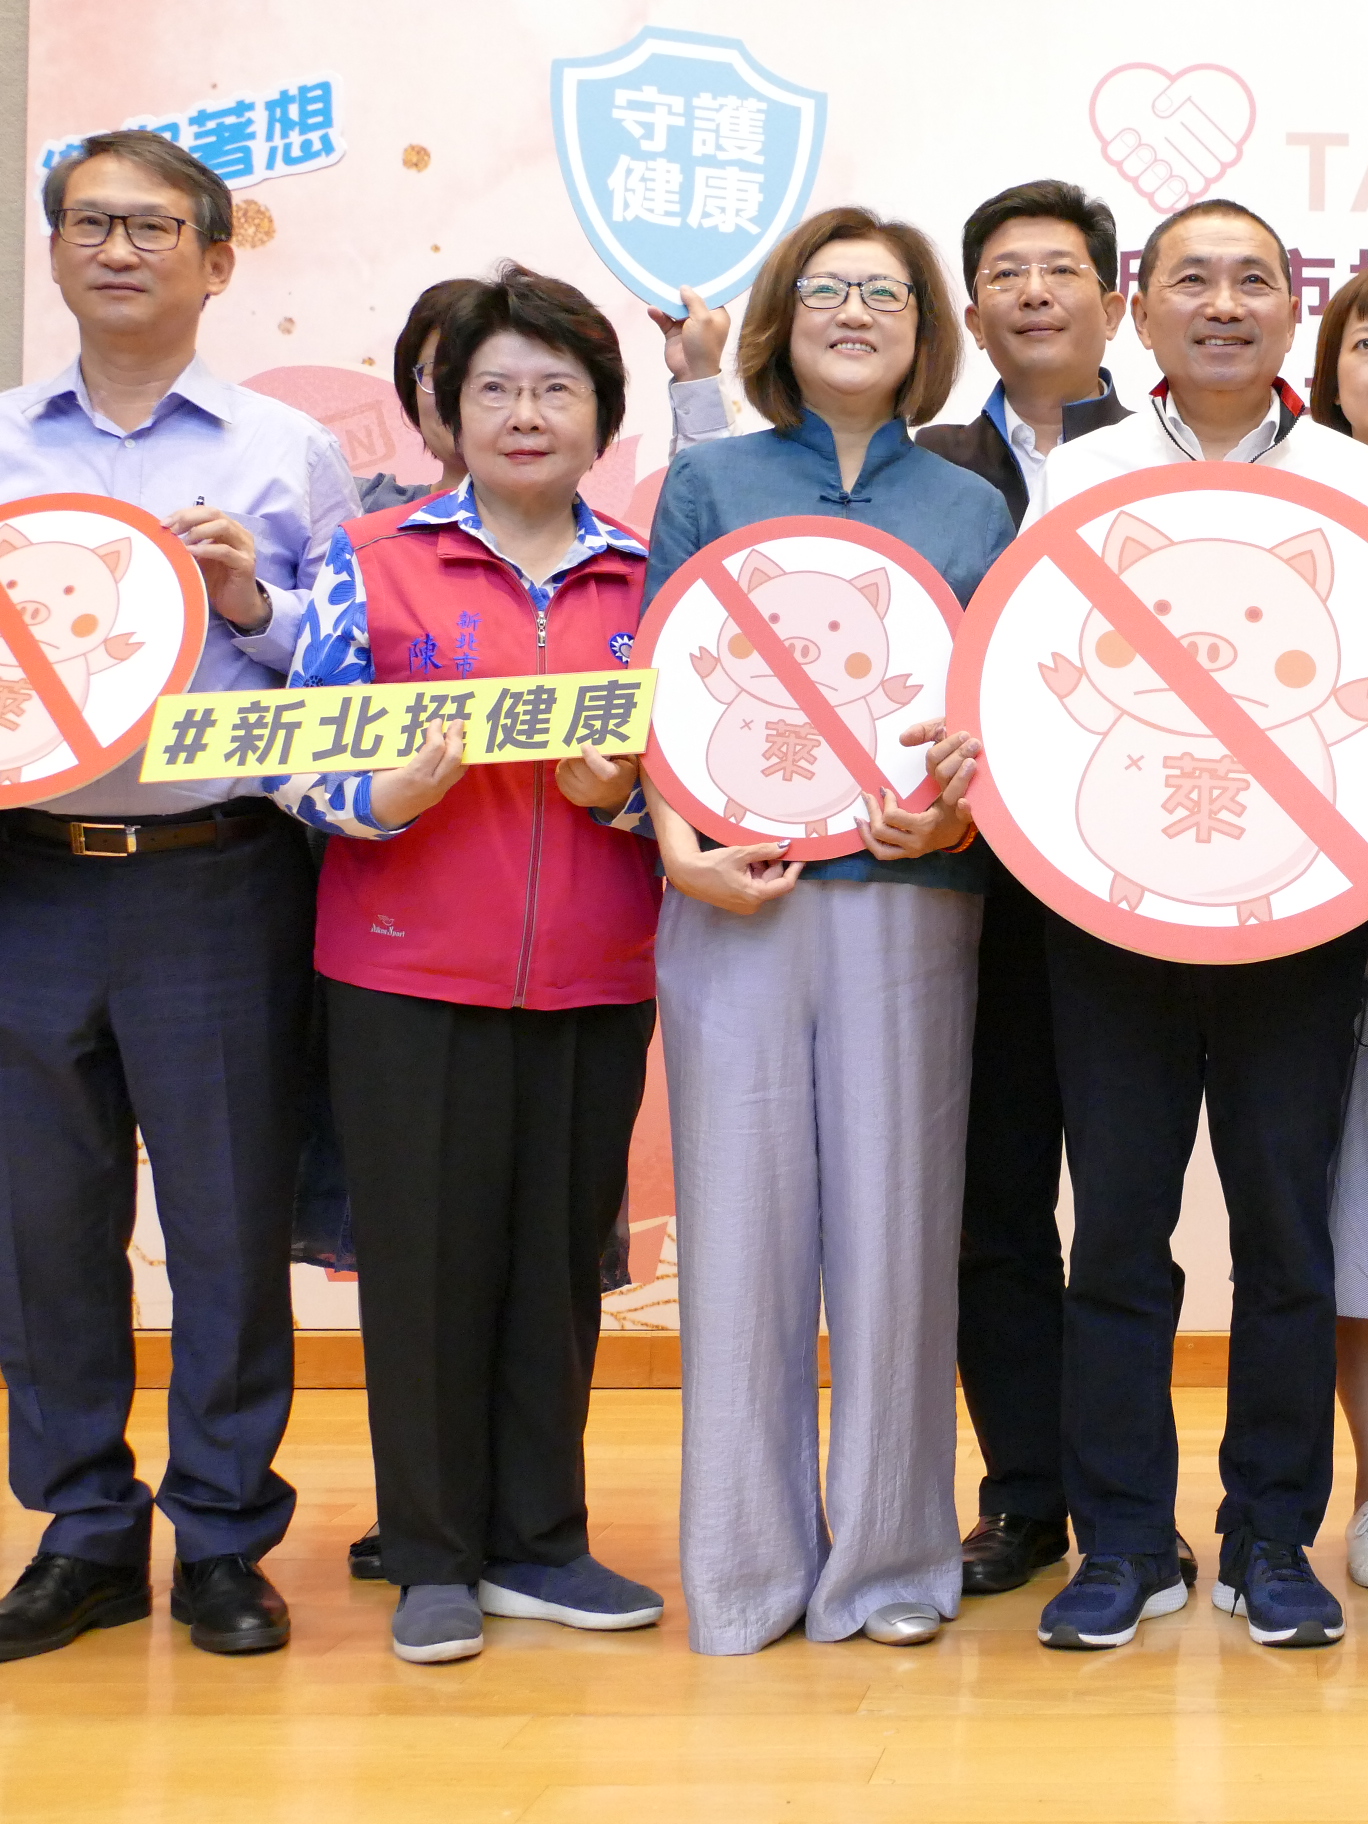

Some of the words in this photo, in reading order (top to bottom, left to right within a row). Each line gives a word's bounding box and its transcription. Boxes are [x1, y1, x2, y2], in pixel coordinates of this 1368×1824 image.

[43, 81, 335, 181] 著想
[612, 85, 767, 165] 守護
[607, 154, 764, 235] 健康
[162, 679, 642, 767] #新北挺健康
[760, 718, 821, 782] 萊
[1161, 751, 1251, 844] 萊
